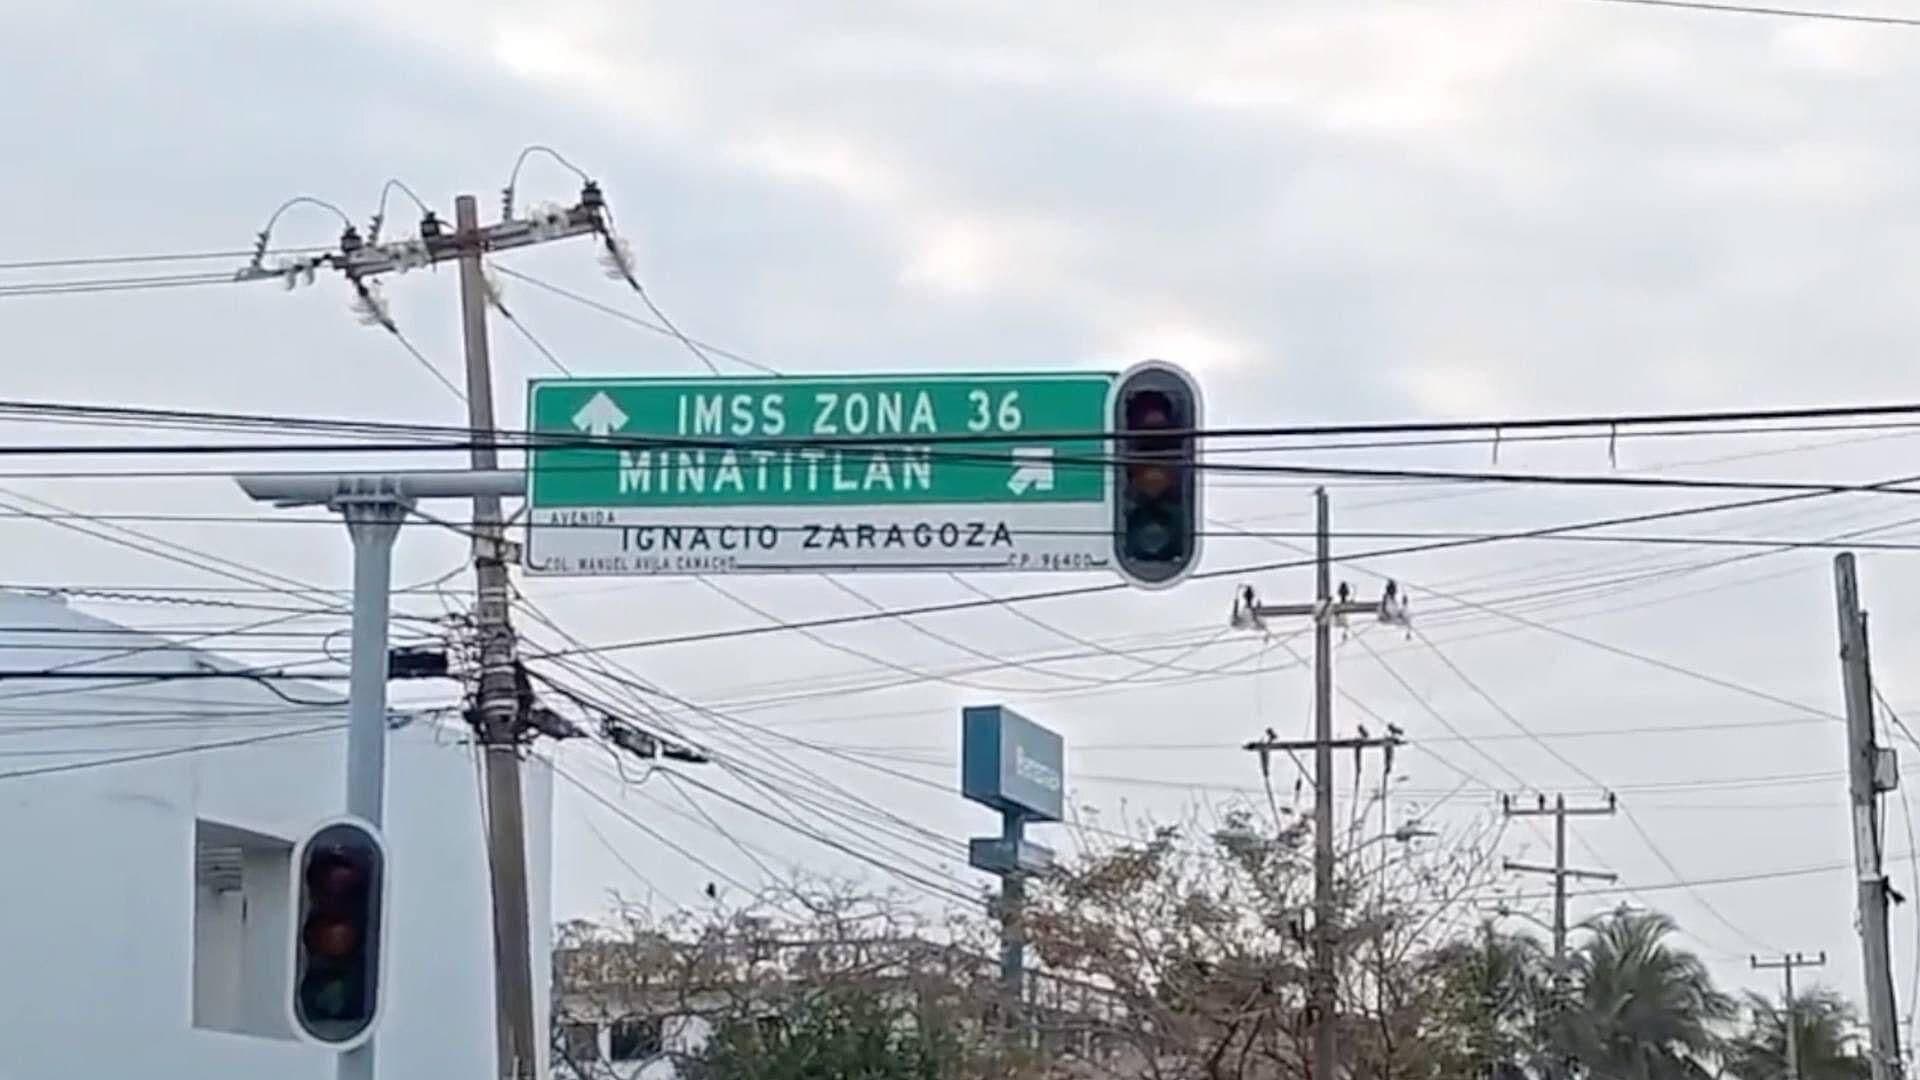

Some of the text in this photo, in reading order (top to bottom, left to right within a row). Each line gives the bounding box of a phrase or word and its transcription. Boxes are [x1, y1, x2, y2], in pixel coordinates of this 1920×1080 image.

[678, 389, 1022, 436] IMSS ZONA 36
[618, 445, 932, 495] MINATITLAN
[551, 511, 615, 525] AVENIDA
[621, 521, 1013, 552] IGNACIO ZARAGOZA
[578, 556, 628, 571] MANUEL
[676, 555, 736, 571] CAMACHO
[1041, 552, 1093, 568] 96400
